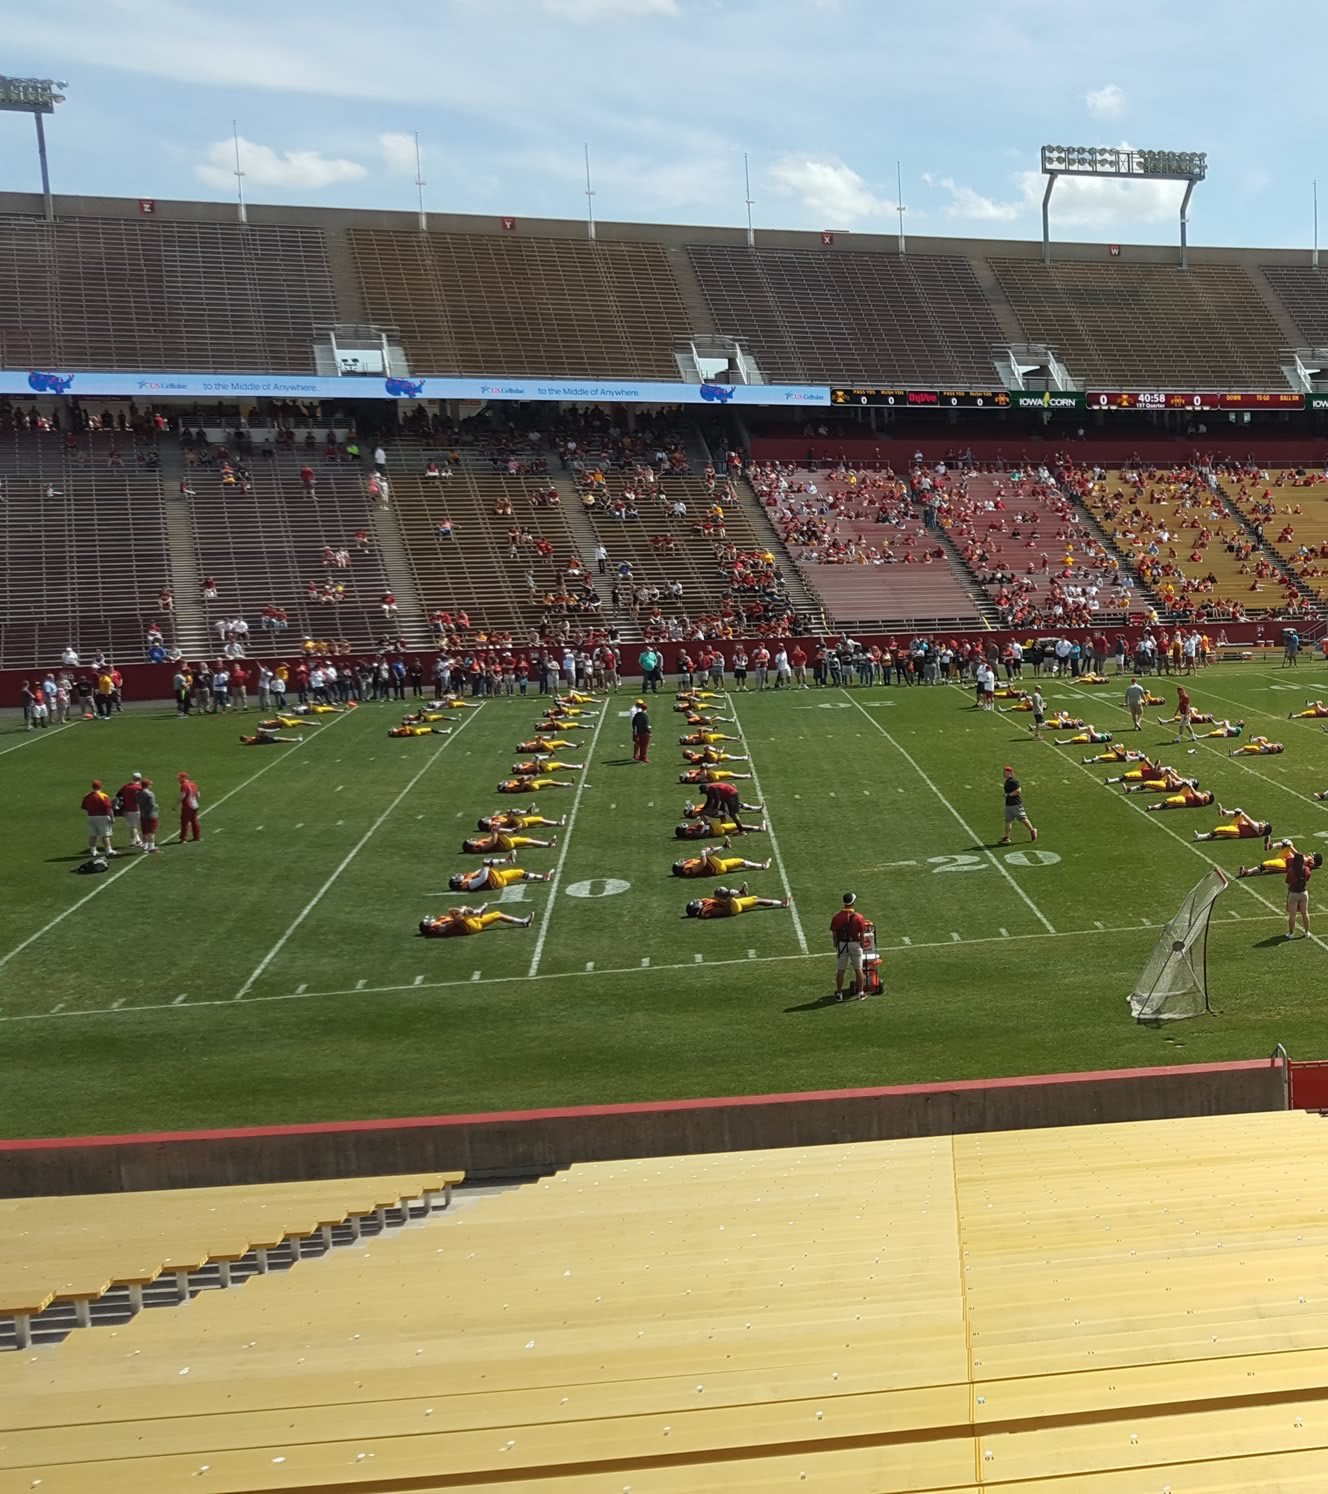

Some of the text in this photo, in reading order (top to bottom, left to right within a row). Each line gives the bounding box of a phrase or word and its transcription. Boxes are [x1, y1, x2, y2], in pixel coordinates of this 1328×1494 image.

[215, 383, 230, 391] the
[231, 383, 260, 391] Middle
[563, 388, 588, 396] Middle
[1019, 399, 1075, 407] IOWA CORN
[1100, 395, 1107, 405] 0
[1138, 394, 1165, 403] 40:58
[1193, 395, 1201, 406] 0
[926, 850, 1061, 873] 20
